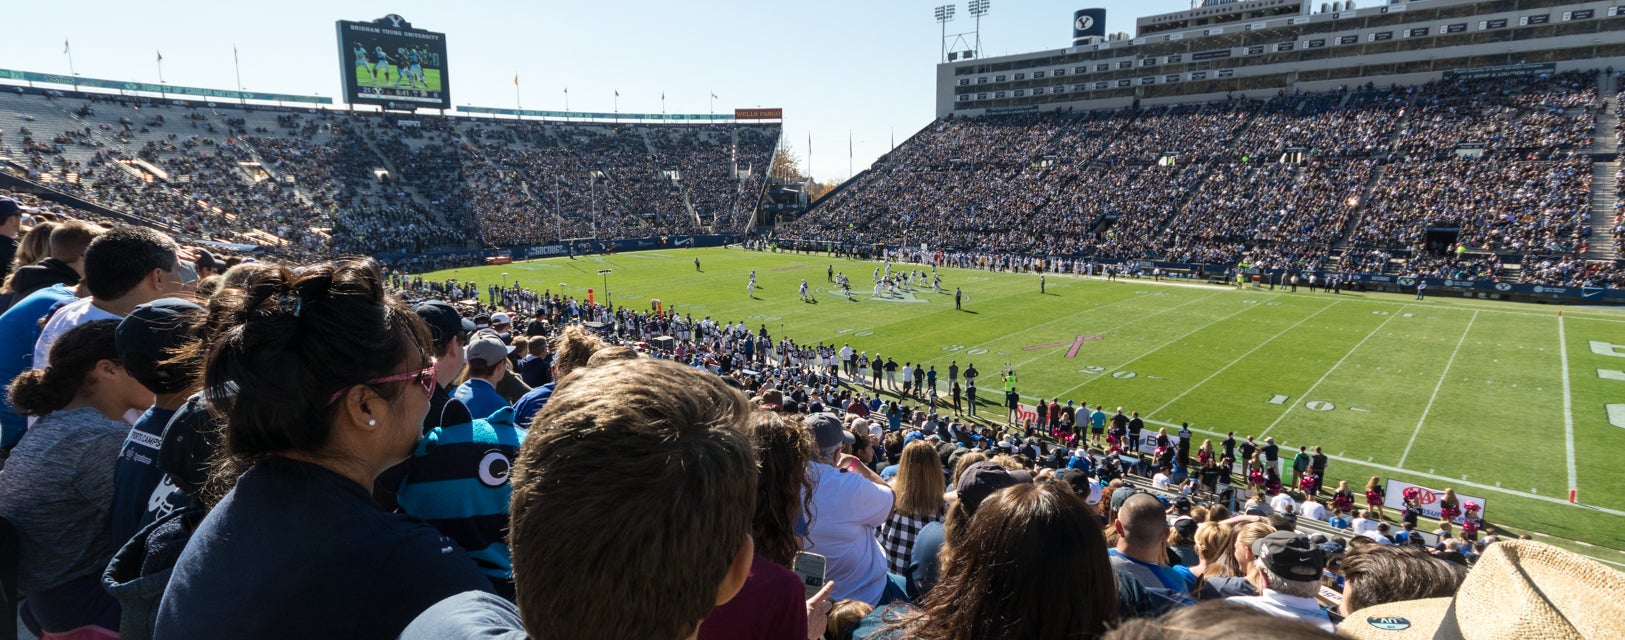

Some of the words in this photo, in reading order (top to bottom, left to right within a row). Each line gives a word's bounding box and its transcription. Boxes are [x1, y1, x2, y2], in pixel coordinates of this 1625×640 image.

[1239, 0, 1284, 10] STADIUM
[1076, 16, 1092, 29] Y
[350, 25, 380, 34] BRIGHAM
[382, 28, 403, 36] YOUNG
[404, 32, 439, 40] UNIVERSITY
